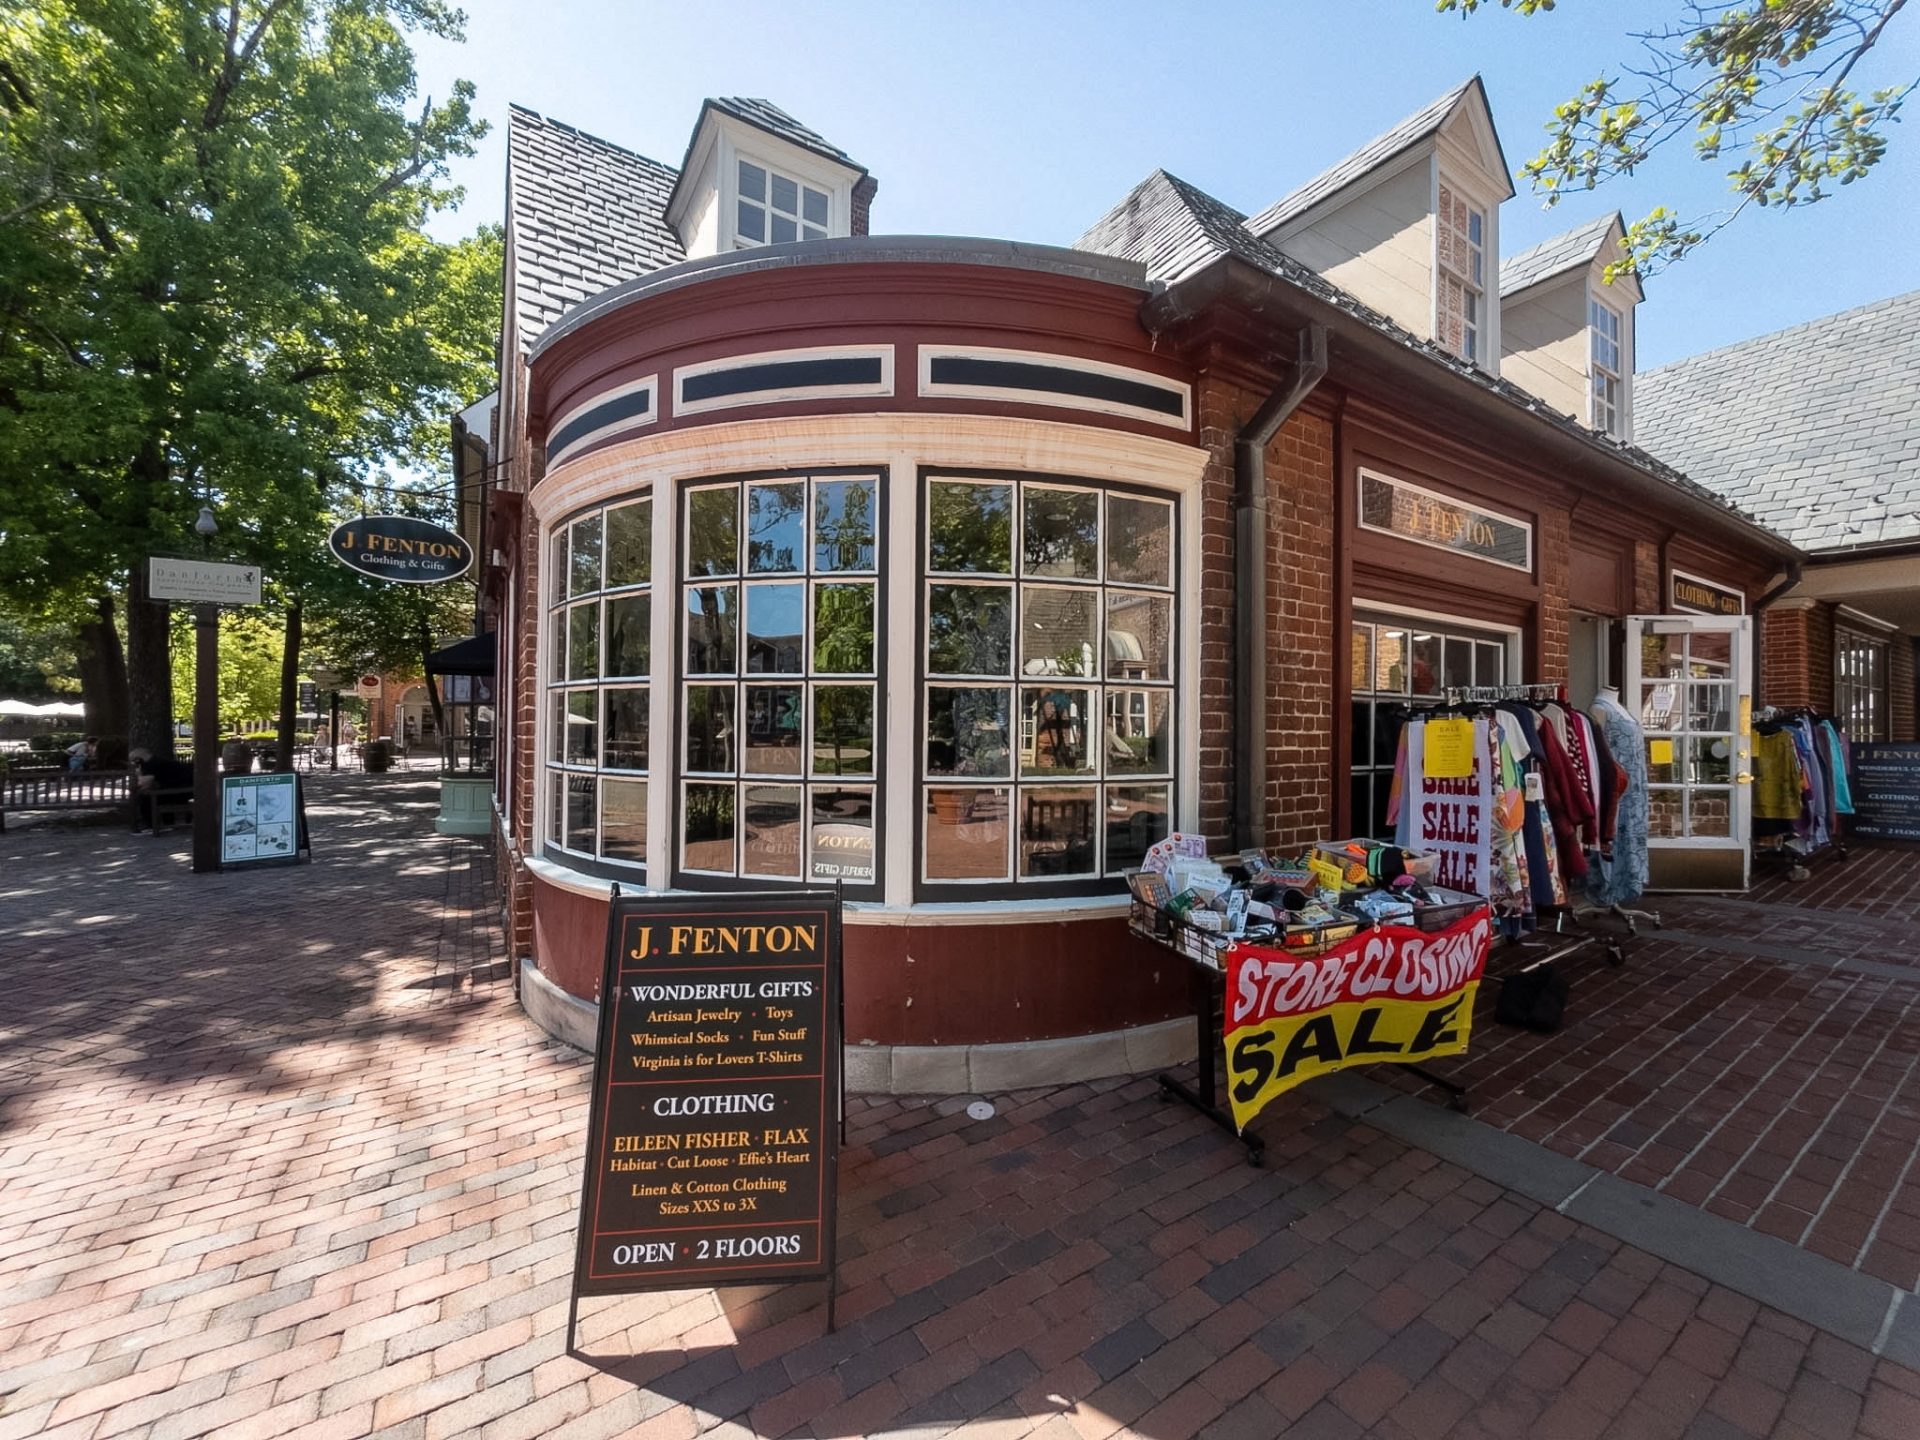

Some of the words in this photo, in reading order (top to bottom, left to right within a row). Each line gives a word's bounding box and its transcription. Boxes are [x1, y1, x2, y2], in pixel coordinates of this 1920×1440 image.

[1431, 506, 1496, 547] FENTON
[367, 533, 462, 559] FENTON
[360, 553, 406, 569] Clothing
[408, 559, 418, 568] &
[421, 560, 445, 571] Gifts
[1675, 582, 1716, 608] CLOTHING
[1867, 793, 1920, 801] CLOTHING
[1422, 801, 1480, 845] SALE
[1425, 848, 1477, 894] ALE
[668, 926, 817, 955] FENTON
[1233, 951, 1358, 1023] STORE
[1350, 918, 1489, 997] CLOSING
[631, 982, 755, 1001] WONDERFUL
[759, 981, 813, 998] GIFTS
[647, 1009, 692, 1023] Artisan
[695, 1008, 742, 1024] Jewelry
[765, 1006, 793, 1021] Toys
[631, 1032, 693, 1046] Whimsical
[695, 1031, 730, 1044] Socks
[752, 1029, 776, 1042] Fun
[778, 1027, 807, 1041] Stuff
[1231, 992, 1466, 1105] SALE
[632, 1055, 681, 1071] Virginia
[683, 1054, 694, 1066] is
[696, 1053, 714, 1066] for
[717, 1052, 754, 1065] Lovers
[756, 1051, 803, 1064] T-Shirts
[653, 1093, 775, 1117] CLOTHING
[613, 1134, 681, 1153] EILEEN
[685, 1131, 750, 1149] FISHER
[763, 1128, 809, 1146] FLAX
[610, 1158, 657, 1172] Habitat
[667, 1157, 690, 1170] Cut
[693, 1156, 729, 1168] Loose
[776, 1152, 810, 1164] Heart
[631, 1184, 667, 1197] Linen
[670, 1183, 683, 1194] &
[686, 1181, 729, 1194] Cotton
[732, 1178, 787, 1192] Clothing
[659, 1202, 690, 1216] Sizes
[692, 1199, 720, 1213] XXS
[723, 1201, 735, 1211] to
[738, 1197, 757, 1211] 3X
[612, 1242, 676, 1265] OPEN
[696, 1239, 710, 1260] 2
[714, 1234, 801, 1260] FLOORS
